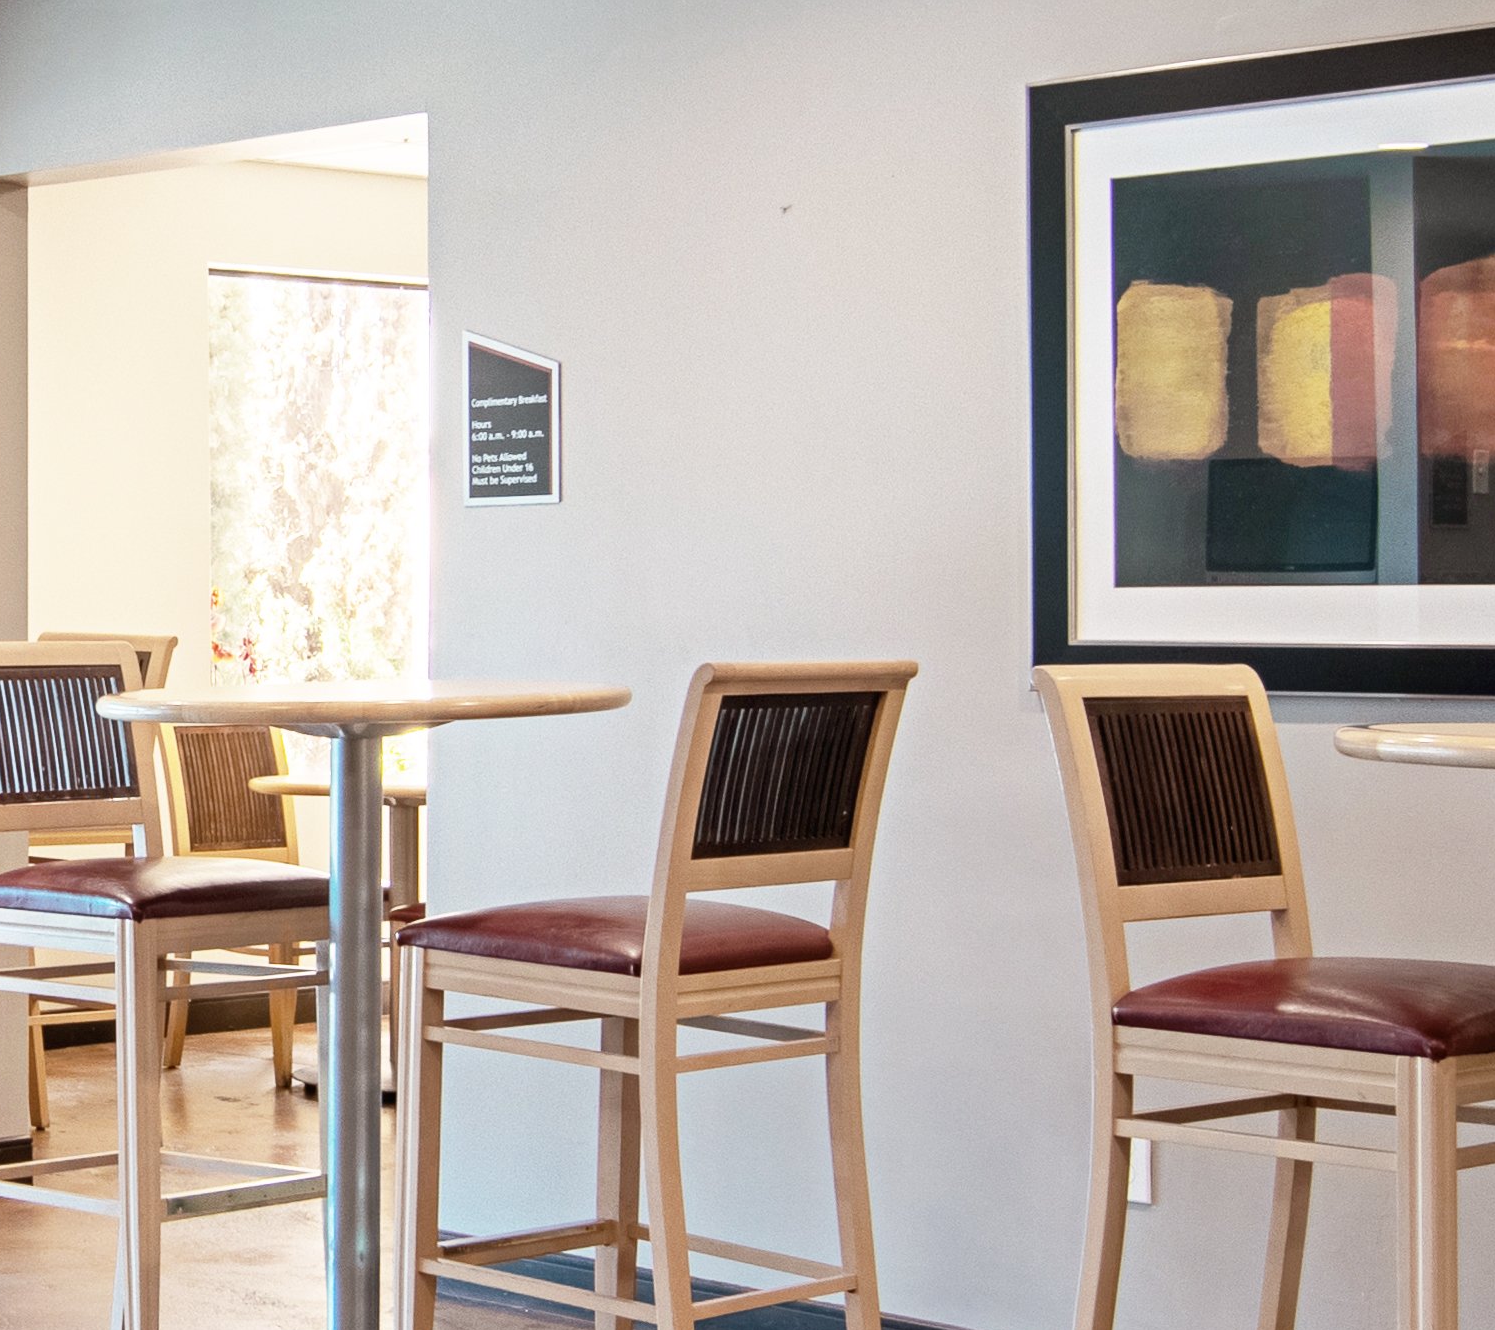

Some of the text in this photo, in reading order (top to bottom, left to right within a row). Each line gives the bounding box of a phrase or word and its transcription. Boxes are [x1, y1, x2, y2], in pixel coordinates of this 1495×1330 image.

[471, 394, 548, 408] Complimentary Breakfast
[471, 421, 492, 430] Hours
[471, 431, 487, 441] 6:00
[488, 432, 505, 441] a.m.
[511, 429, 527, 439] 9:00
[528, 430, 544, 438] a.m.
[471, 451, 527, 463] No Pets Allowed
[472, 465, 501, 474] Children
[502, 463, 523, 473] Under
[472, 474, 538, 486] Must be Supervised
